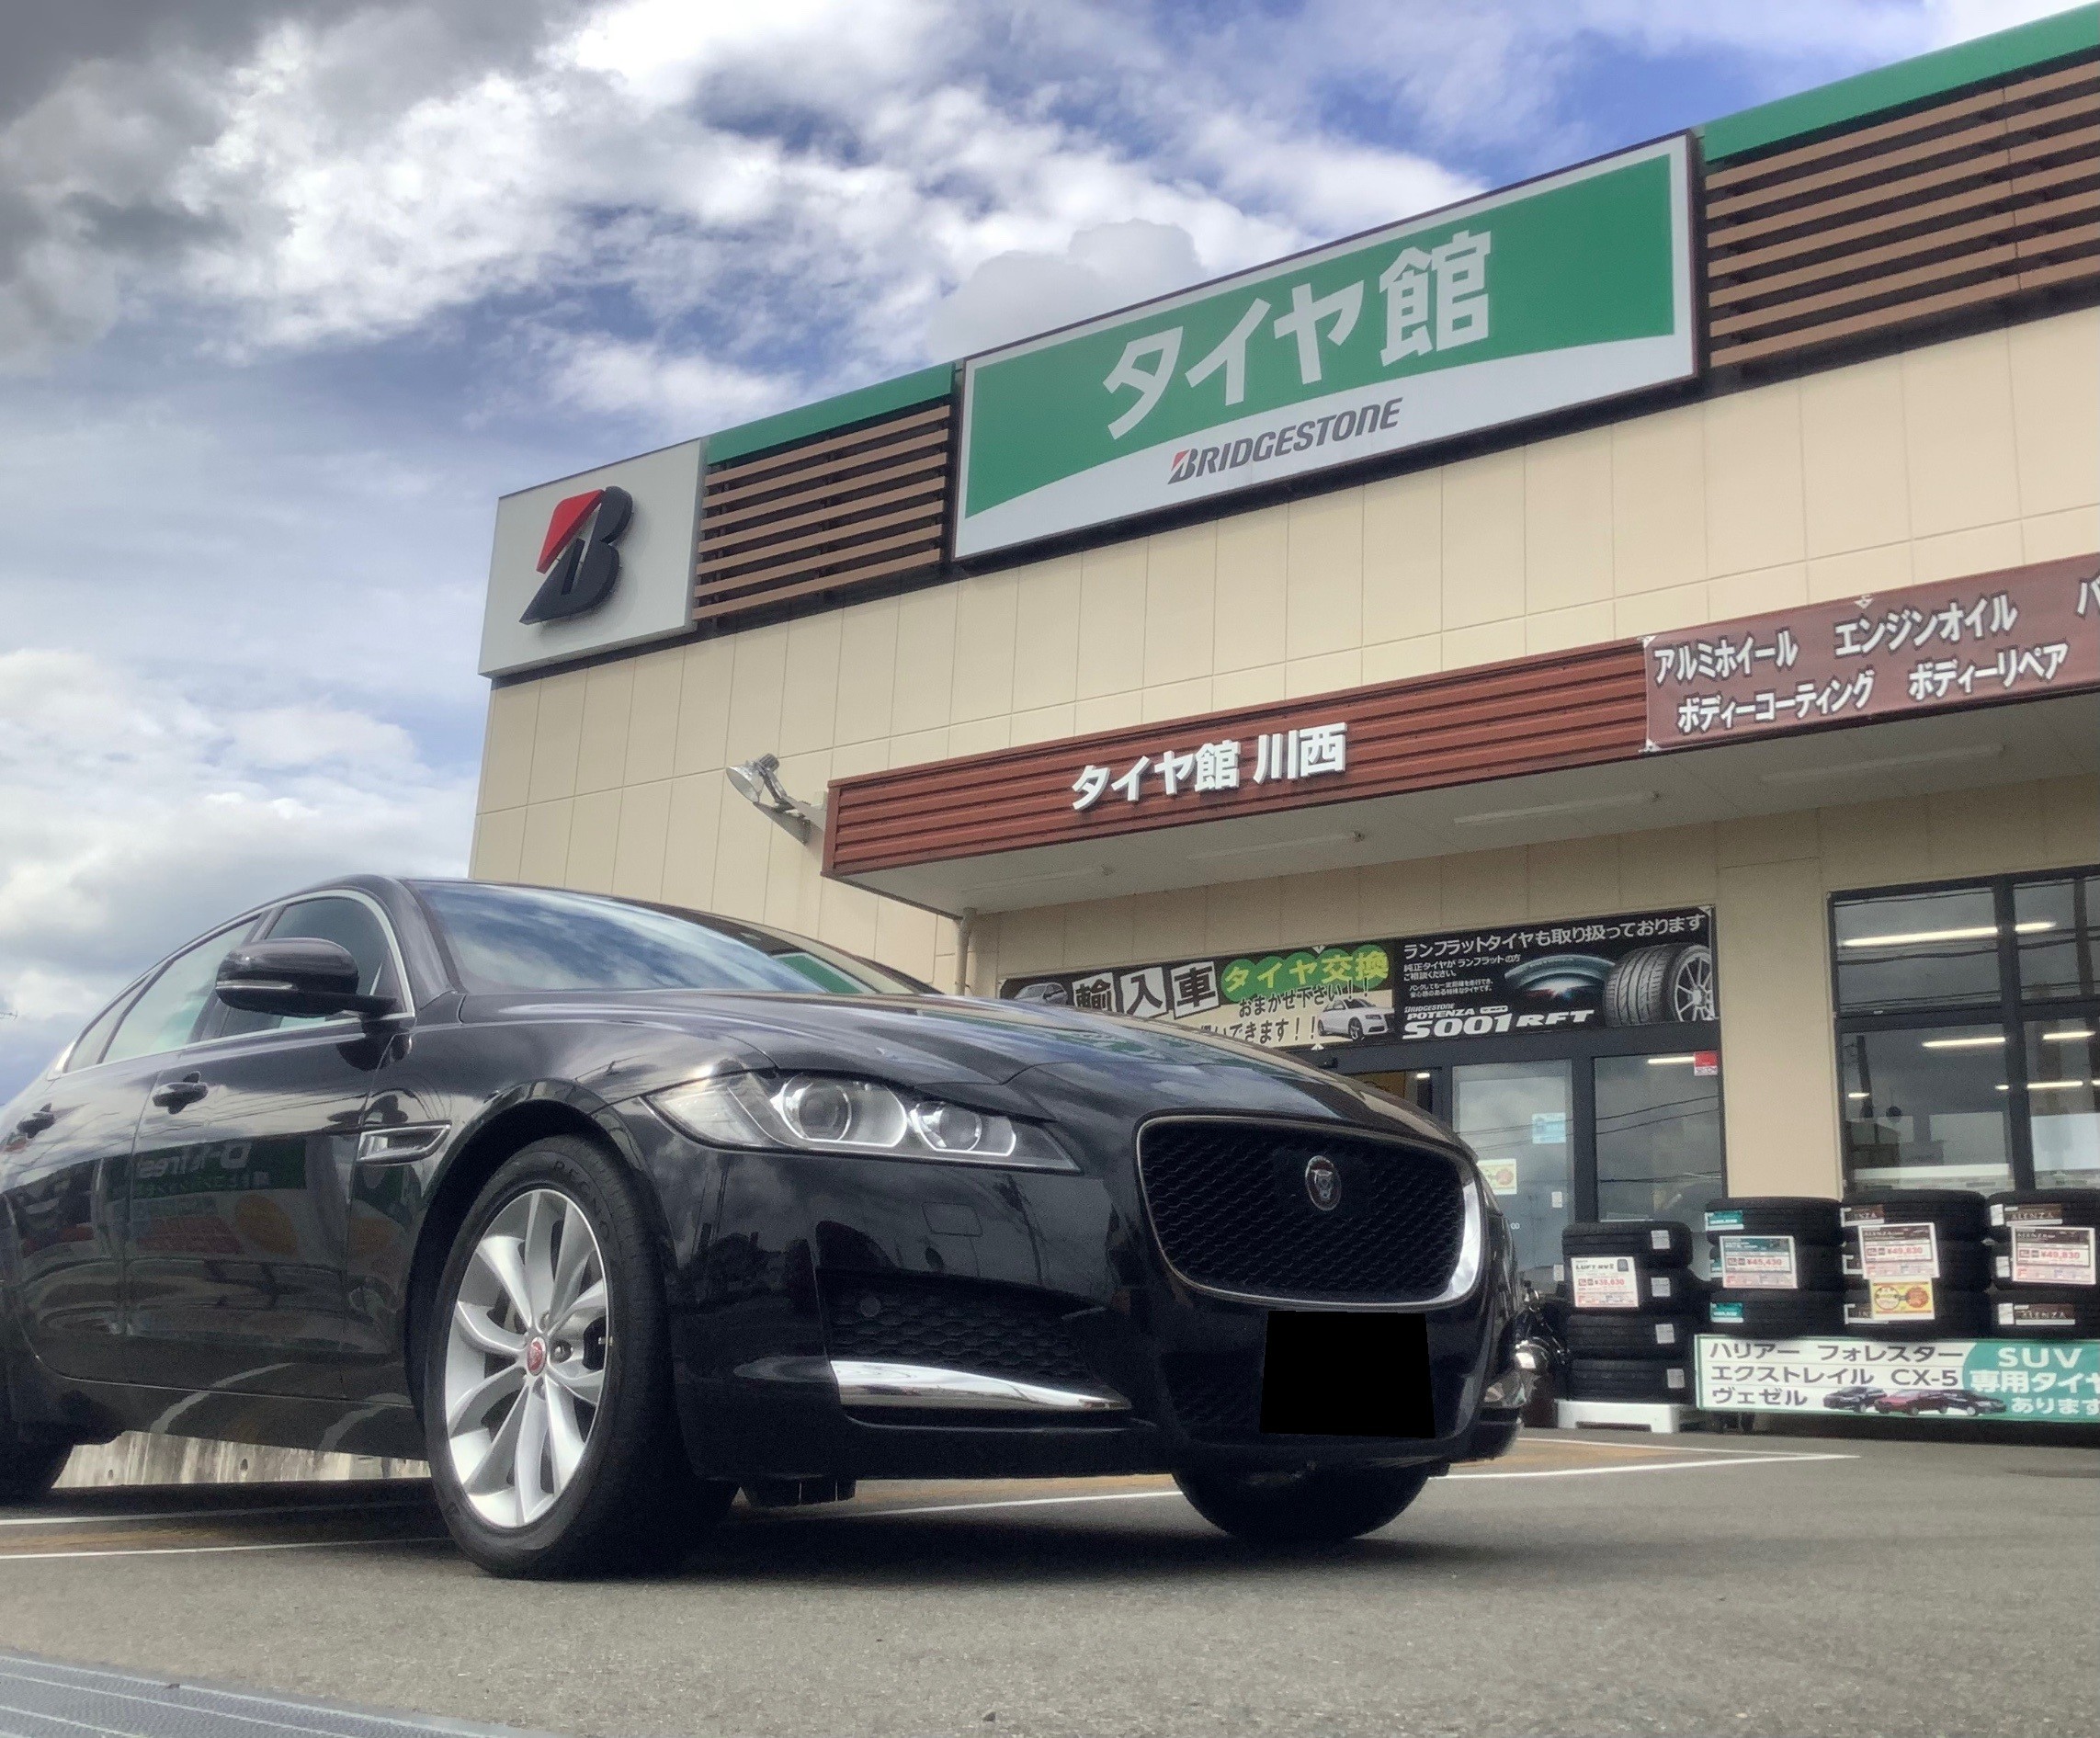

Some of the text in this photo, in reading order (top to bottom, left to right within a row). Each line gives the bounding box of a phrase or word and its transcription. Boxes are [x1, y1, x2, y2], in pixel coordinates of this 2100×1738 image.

[1104, 231, 1492, 440] タイヤ館
[1168, 397, 1403, 484] BRIDGESTONE
[1653, 630, 1799, 685] アルミホイール
[1834, 593, 2017, 658] エンジンオイル
[1676, 643, 2069, 733] ボディーコーティング ボディーリペア
[1072, 721, 1348, 810] タイヤ館 川西
[1404, 914, 1706, 960] ランフラットタイヤも取り扱っております
[1225, 950, 1389, 993] タイヤ交換
[1402, 1009, 1595, 1039] S001 RFT
[1404, 1003, 1455, 1013] BRIDGESTONE
[1407, 1008, 1475, 1020] POTENZA
[1709, 1343, 1964, 1362] ハリアー フォレスター
[1997, 1346, 2083, 1369] SUV
[1710, 1366, 1958, 1387] エクストレイル CX-5
[1711, 1387, 1808, 1407] ヴェゼル
